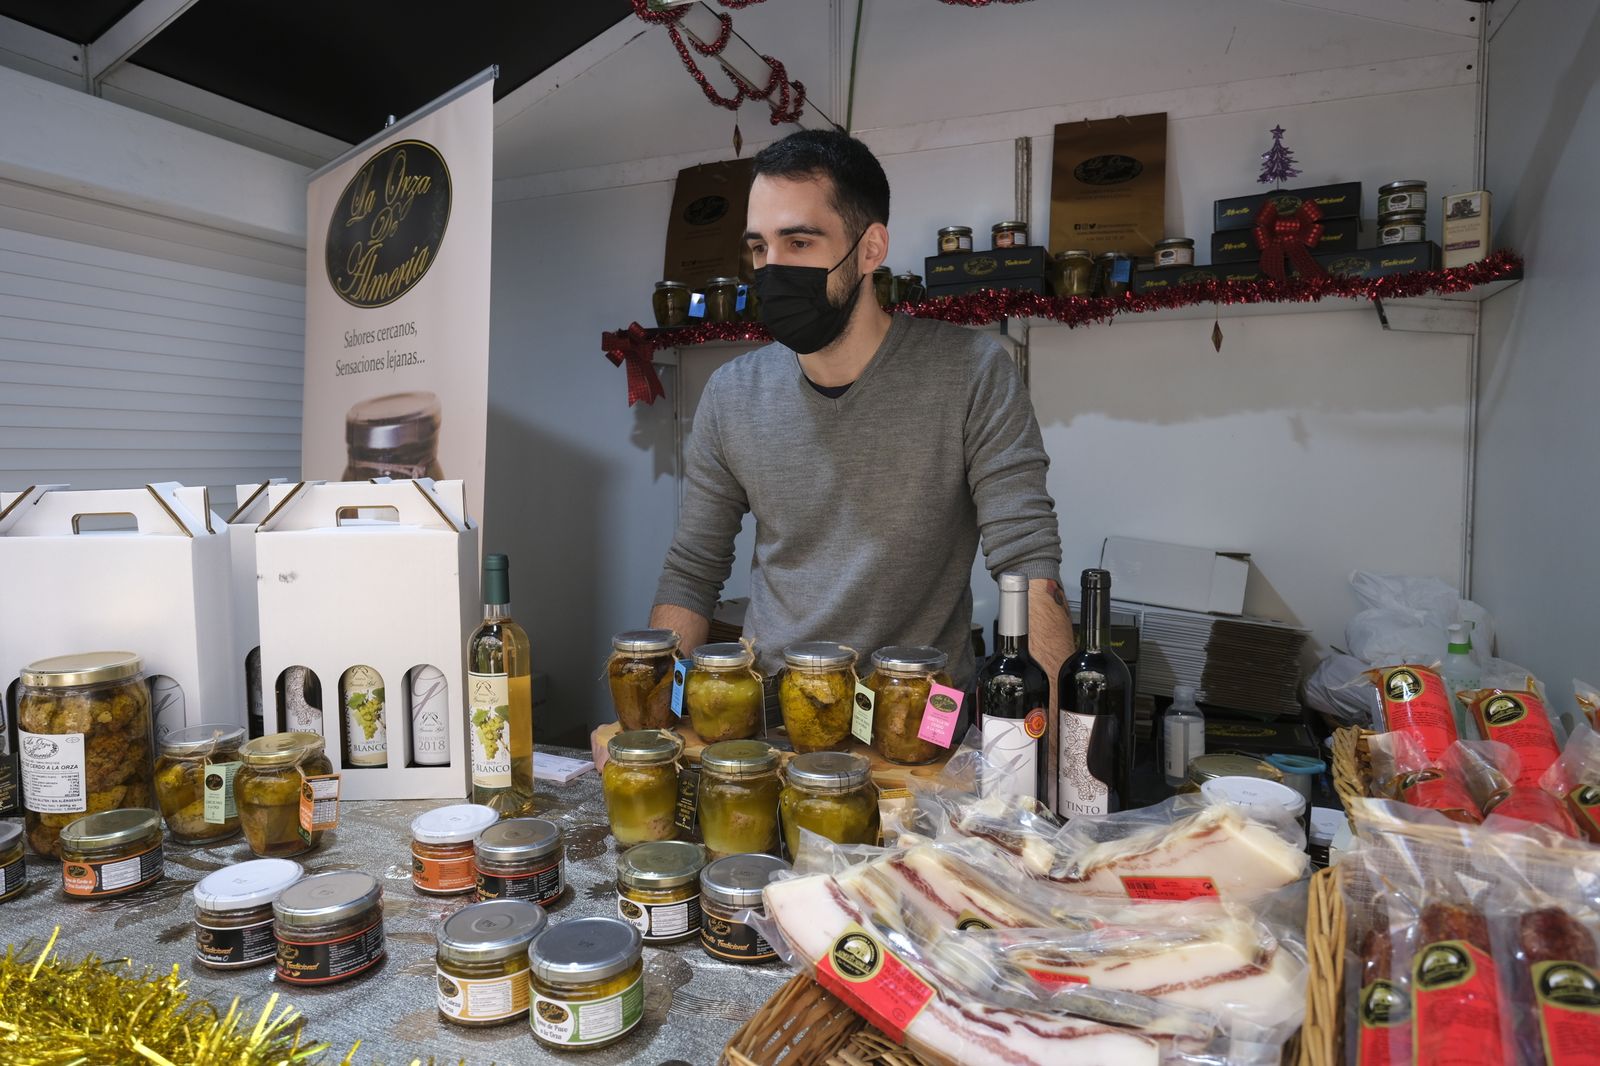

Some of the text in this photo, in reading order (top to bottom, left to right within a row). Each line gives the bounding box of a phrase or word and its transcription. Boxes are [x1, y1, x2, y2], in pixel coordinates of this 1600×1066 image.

[344, 320, 418, 349] Sabores cercanos,
[335, 350, 426, 377] Sensaciones lejanas...
[419, 740, 446, 751] 2018
[476, 763, 510, 773] BLANCO
[1065, 800, 1100, 815] TINTO
